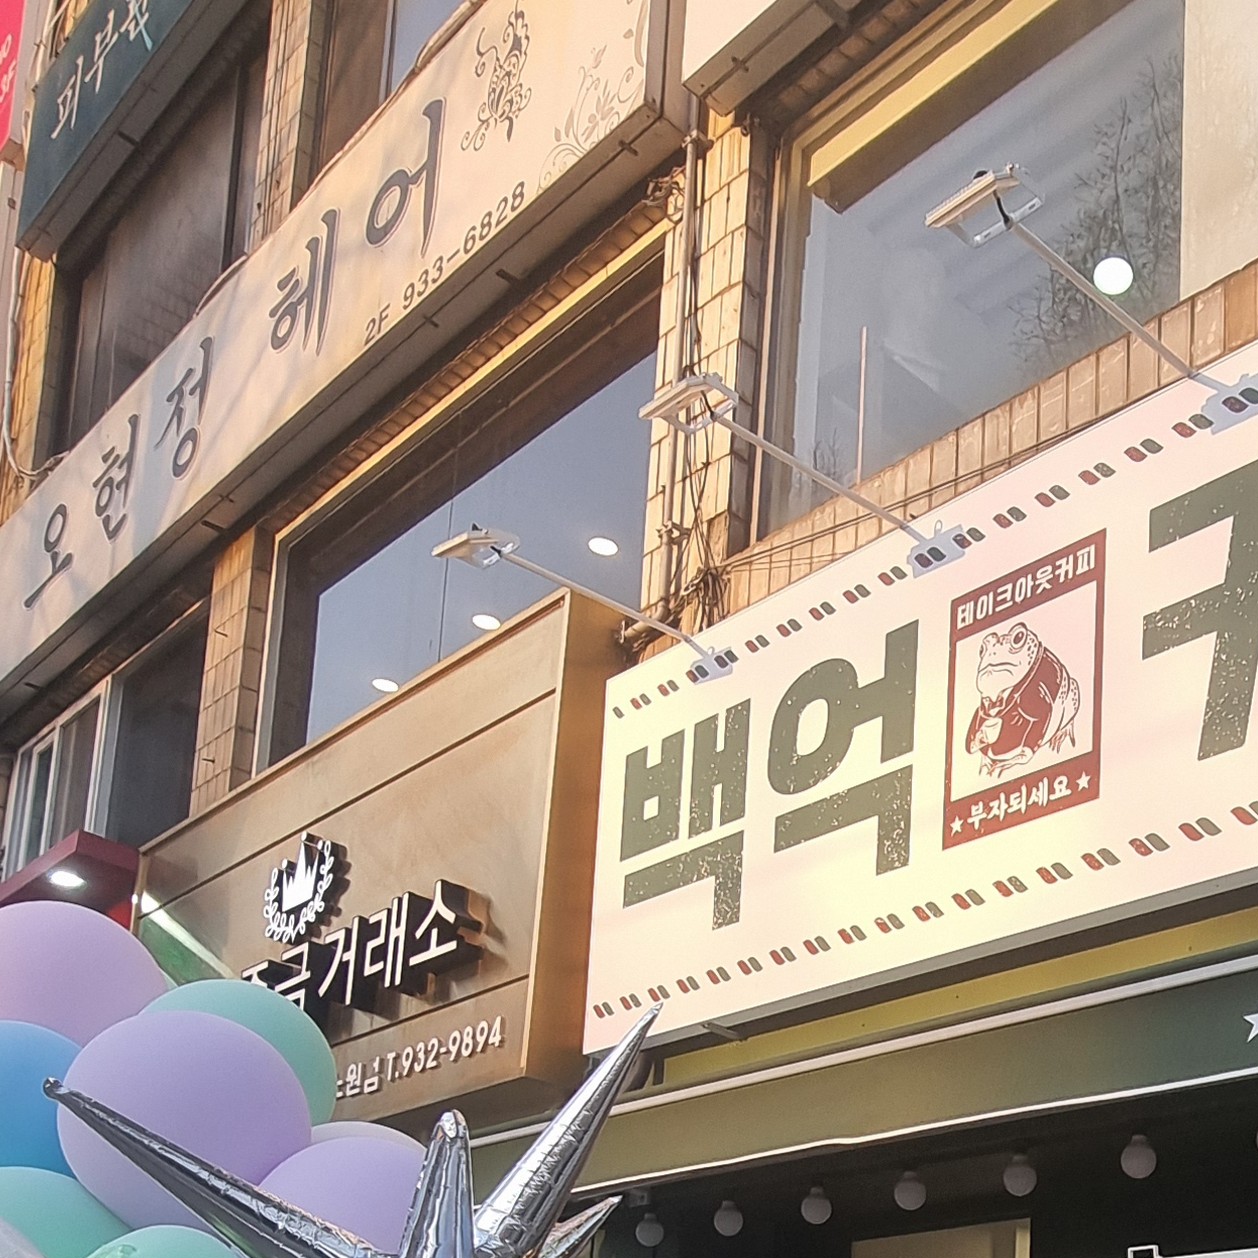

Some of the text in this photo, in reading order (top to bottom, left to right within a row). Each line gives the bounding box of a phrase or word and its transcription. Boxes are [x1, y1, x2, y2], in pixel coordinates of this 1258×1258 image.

[364, 181, 527, 347] 2F 933-6828
[24, 97, 447, 609] 오현정 헤어
[956, 543, 1097, 629] 테이크아웃커피
[620, 619, 919, 931] 백억
[966, 775, 1073, 831] 부자되세요
[387, 1015, 503, 1082] T.932-9894
